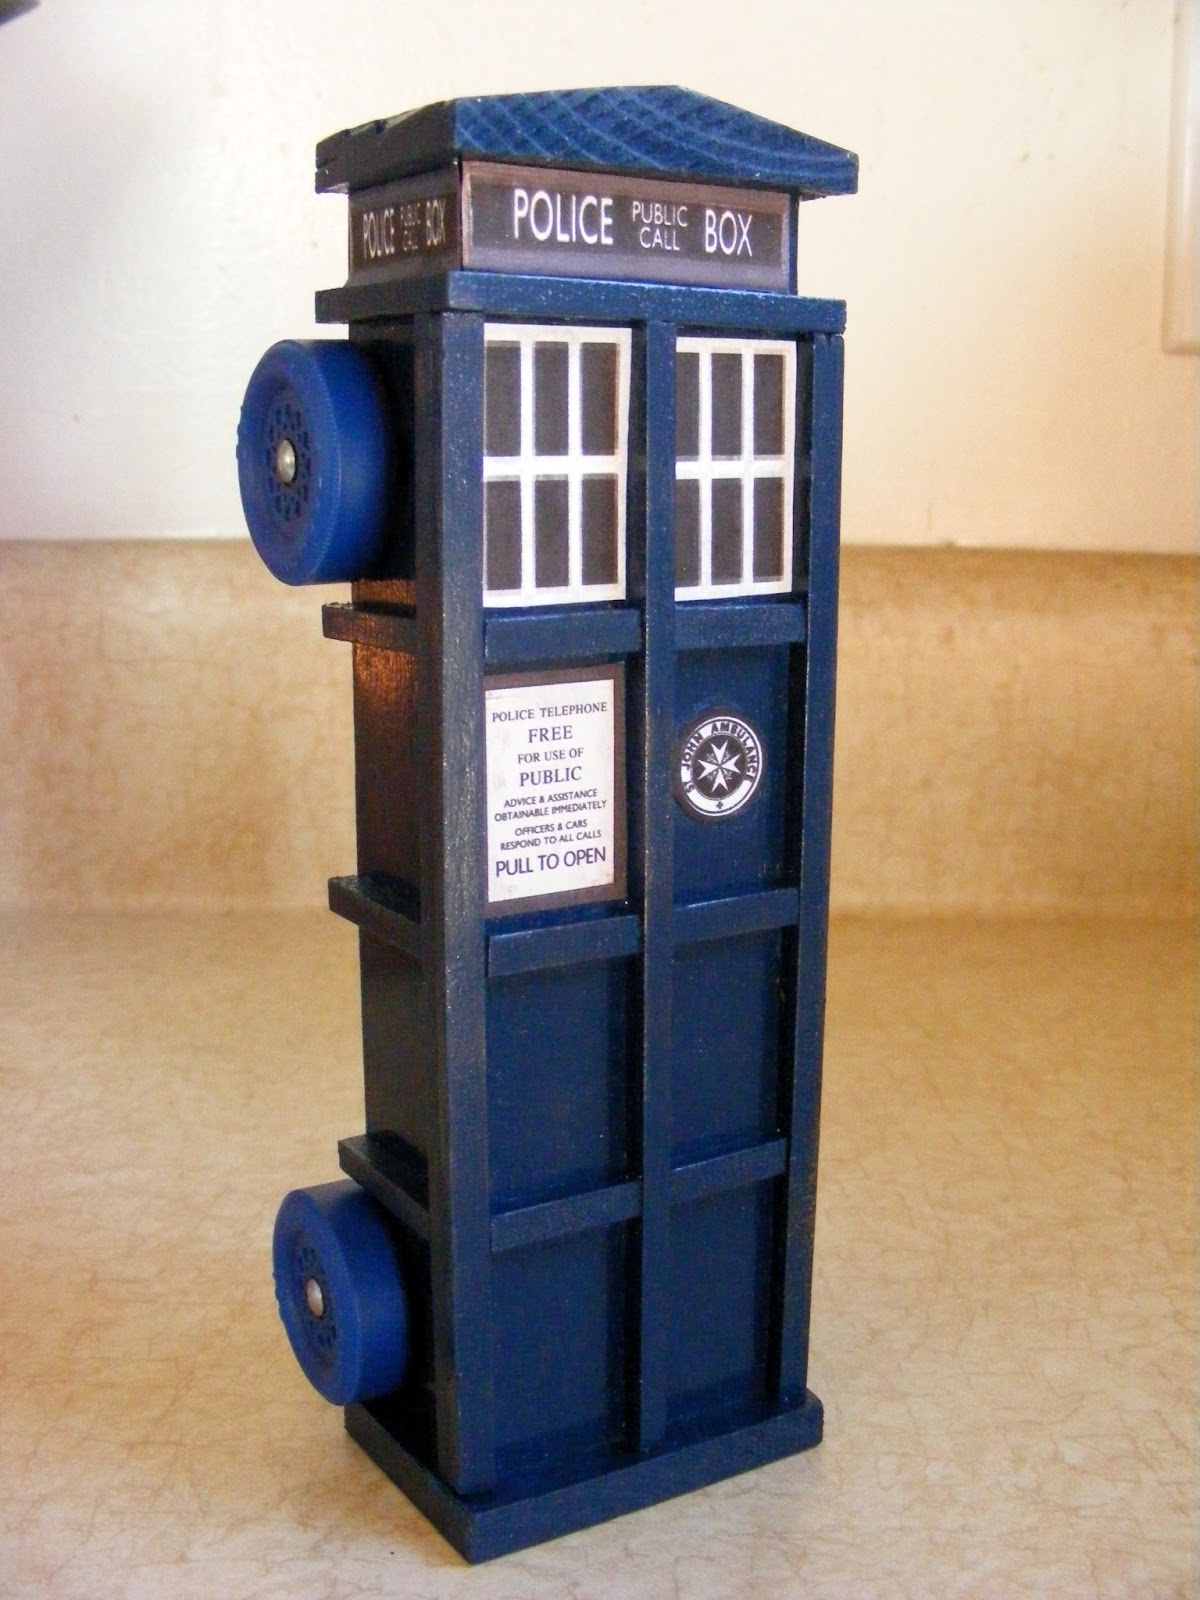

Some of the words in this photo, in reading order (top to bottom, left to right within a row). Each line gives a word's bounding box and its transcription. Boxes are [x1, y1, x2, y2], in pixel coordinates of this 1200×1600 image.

[426, 199, 446, 246] BOX
[512, 188, 614, 246] POLICE
[632, 200, 688, 228] PUBLIC
[363, 208, 395, 259] POLICE
[639, 226, 680, 251] CALL
[704, 208, 753, 257] BOX
[492, 709, 535, 723] POLICE
[539, 702, 608, 718] TELEPHONE
[528, 725, 573, 743] FREE
[517, 752, 541, 764] FOR
[544, 750, 566, 762] USE
[568, 747, 584, 759] OF
[681, 732, 704, 771] JOHN
[711, 721, 757, 783] AMBULANCE
[519, 766, 582, 787] PUBLIC
[504, 796, 537, 808] ADVICE
[539, 795, 545, 804] &
[547, 789, 598, 803] ASSISTANCE
[494, 807, 549, 822] OBTAINABLE
[551, 800, 607, 815] IMMEDIATELY
[515, 824, 555, 837] OFFICERS
[557, 822, 563, 831] &
[565, 819, 588, 830] CARS
[500, 838, 541, 851] RESPOND
[544, 836, 557, 845] TO
[558, 833, 574, 843] ALL
[576, 829, 602, 841] CALLS
[496, 857, 534, 877] PULL
[538, 853, 560, 871] TO
[563, 846, 606, 867] OPEN
